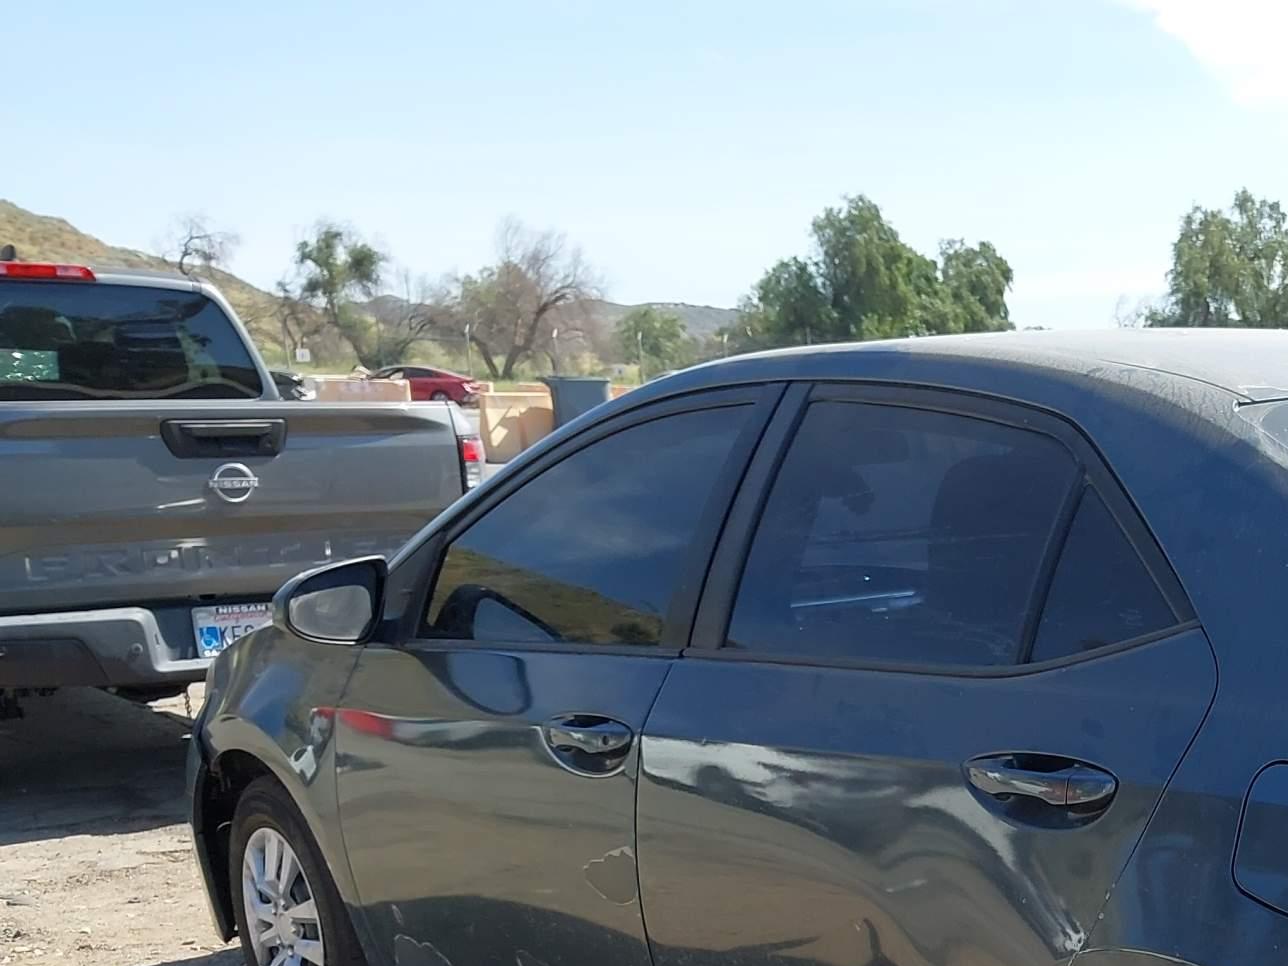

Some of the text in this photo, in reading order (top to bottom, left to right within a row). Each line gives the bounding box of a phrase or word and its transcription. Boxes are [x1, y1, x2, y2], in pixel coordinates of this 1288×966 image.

[209, 477, 259, 489] NISSAN
[22, 537, 406, 583] FRONTIE
[218, 604, 267, 614] NISSAN
